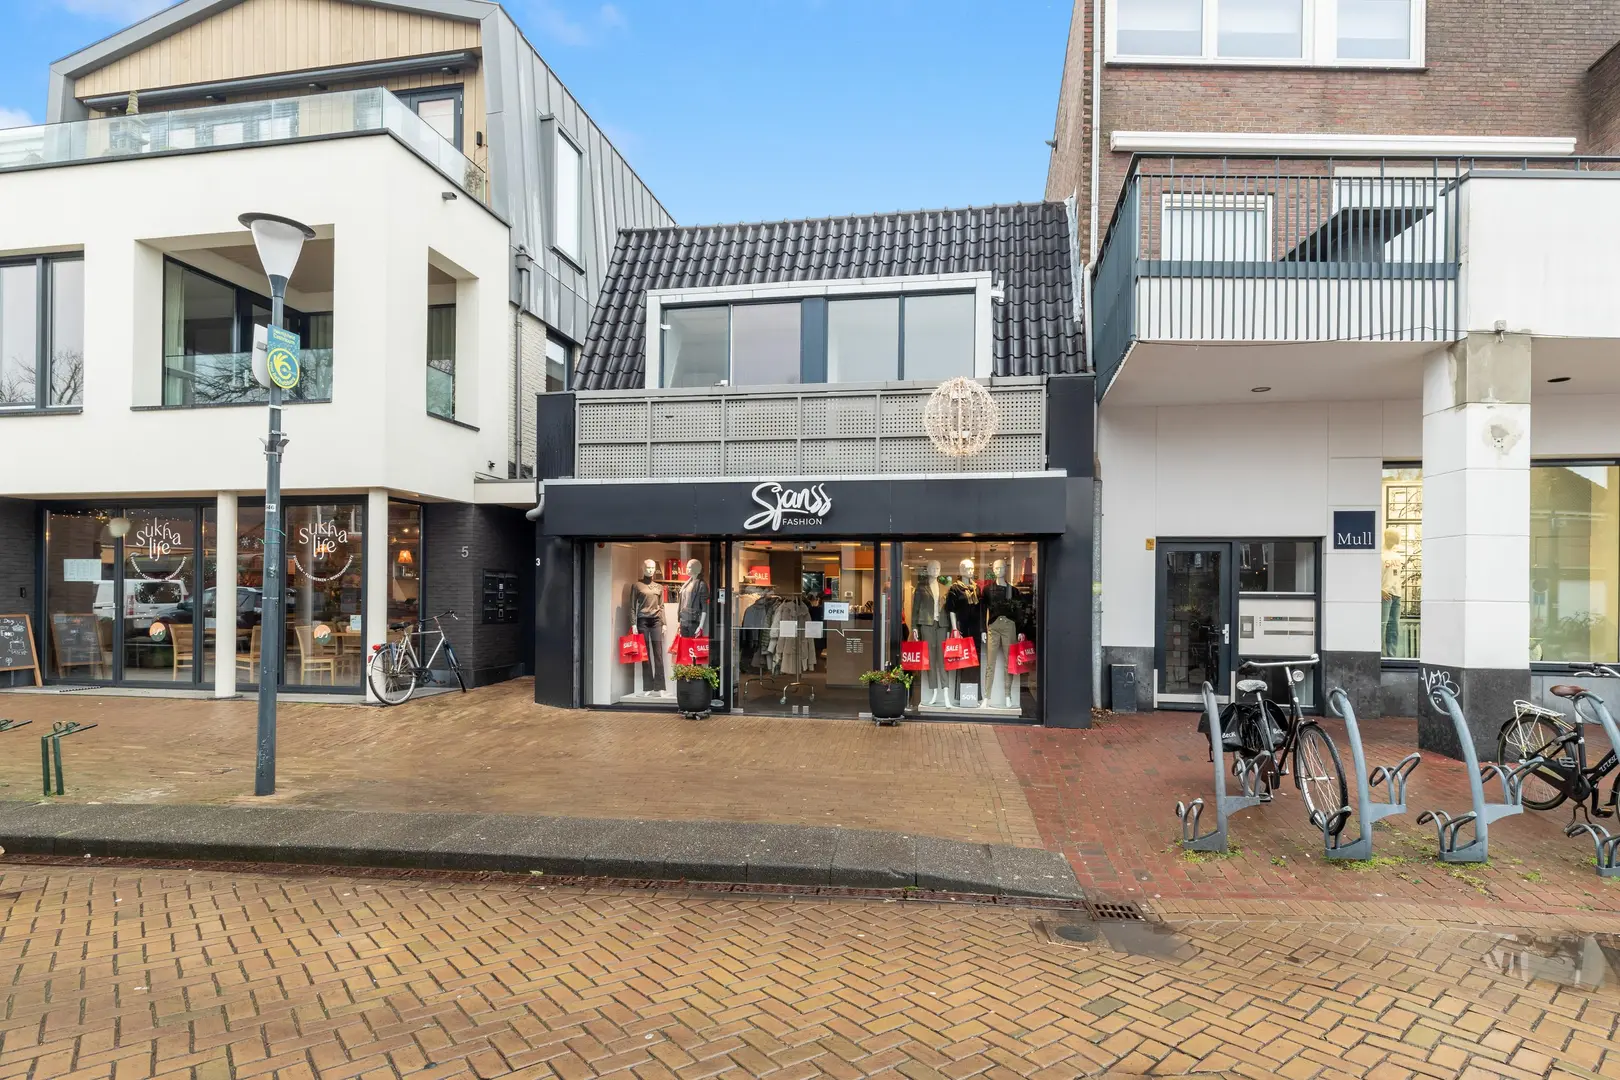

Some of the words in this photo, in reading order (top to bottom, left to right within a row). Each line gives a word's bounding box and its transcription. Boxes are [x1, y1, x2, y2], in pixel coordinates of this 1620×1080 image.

[782, 518, 823, 526] FASHION
[1337, 531, 1373, 545] Mull
[149, 537, 171, 561] life
[313, 534, 337, 559] life
[460, 546, 469, 558] 5
[535, 557, 541, 567] 3
[754, 572, 769, 580] SALE
[946, 644, 959, 652] SALE
[902, 651, 921, 662] SALE
